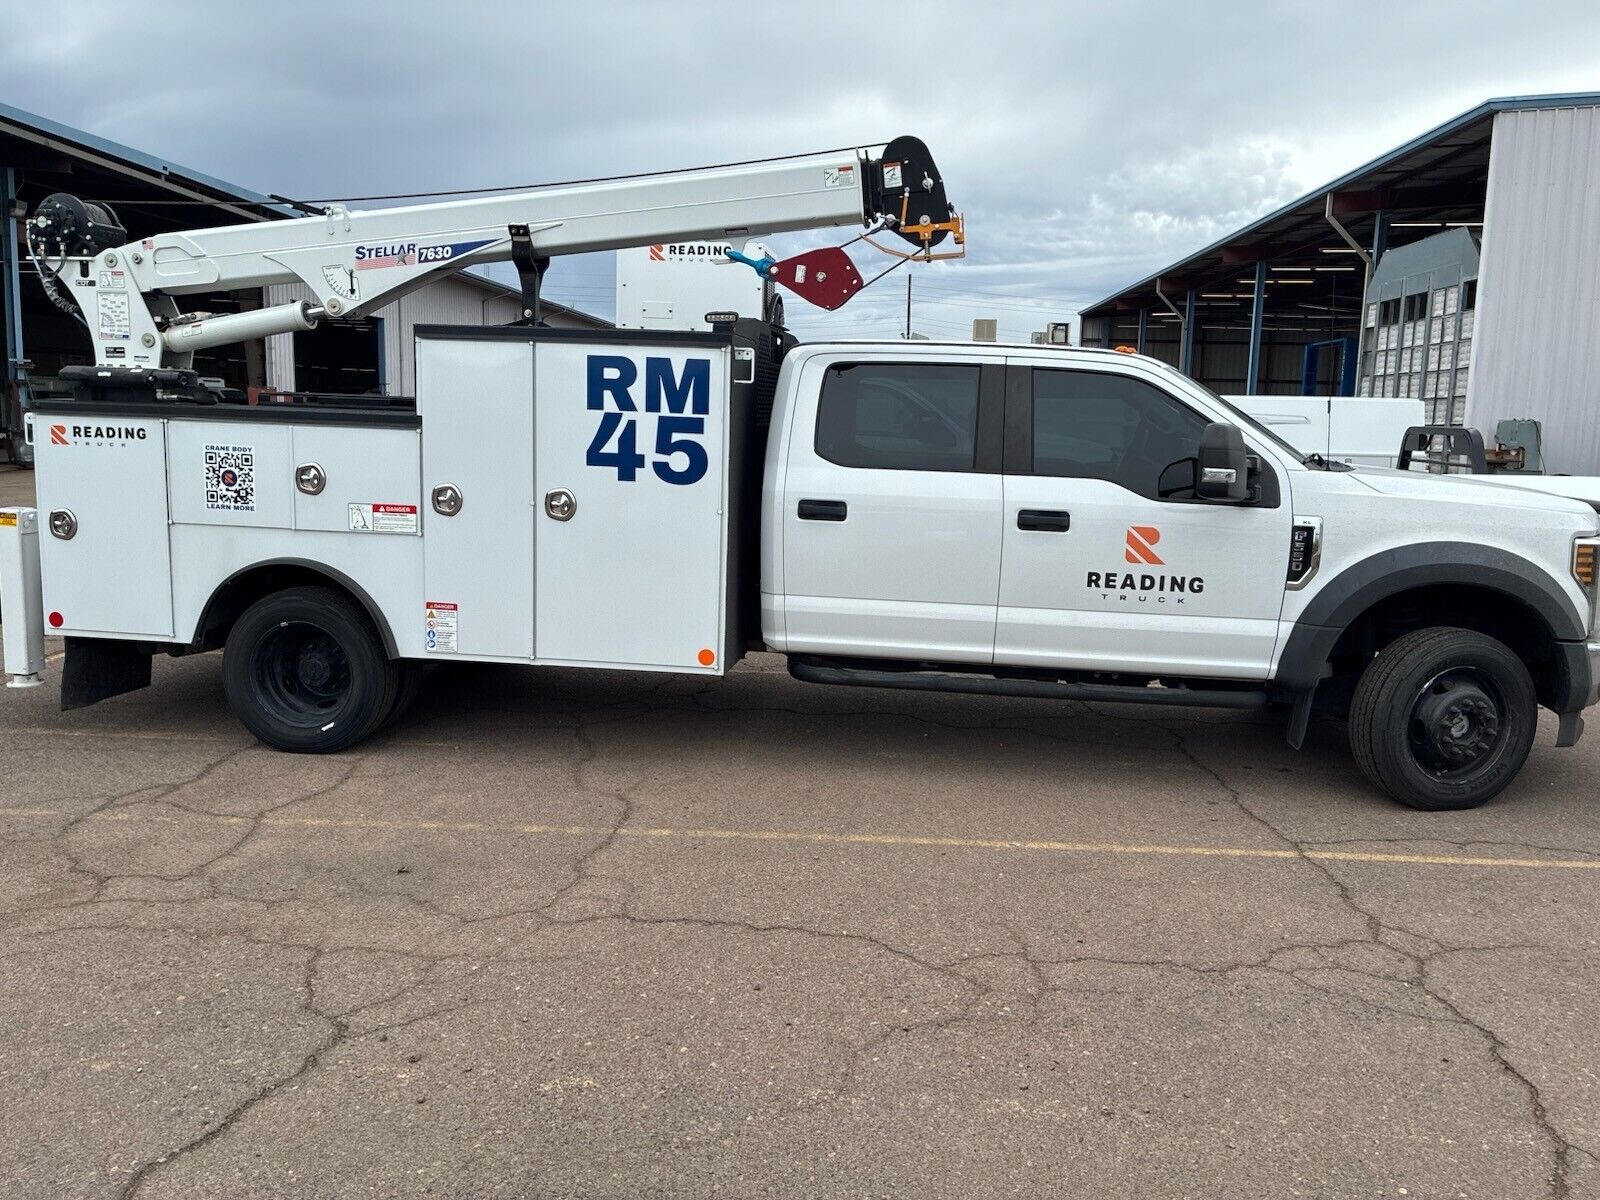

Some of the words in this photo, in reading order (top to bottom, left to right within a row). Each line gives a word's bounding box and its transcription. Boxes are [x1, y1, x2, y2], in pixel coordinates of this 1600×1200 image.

[355, 243, 415, 260] STELLAR
[420, 247, 452, 260] 7630
[586, 354, 711, 415] RM
[72, 426, 147, 440] READING
[586, 411, 709, 486] 45
[1086, 571, 1204, 594] READING
[1101, 594, 1185, 604] TRUCK
